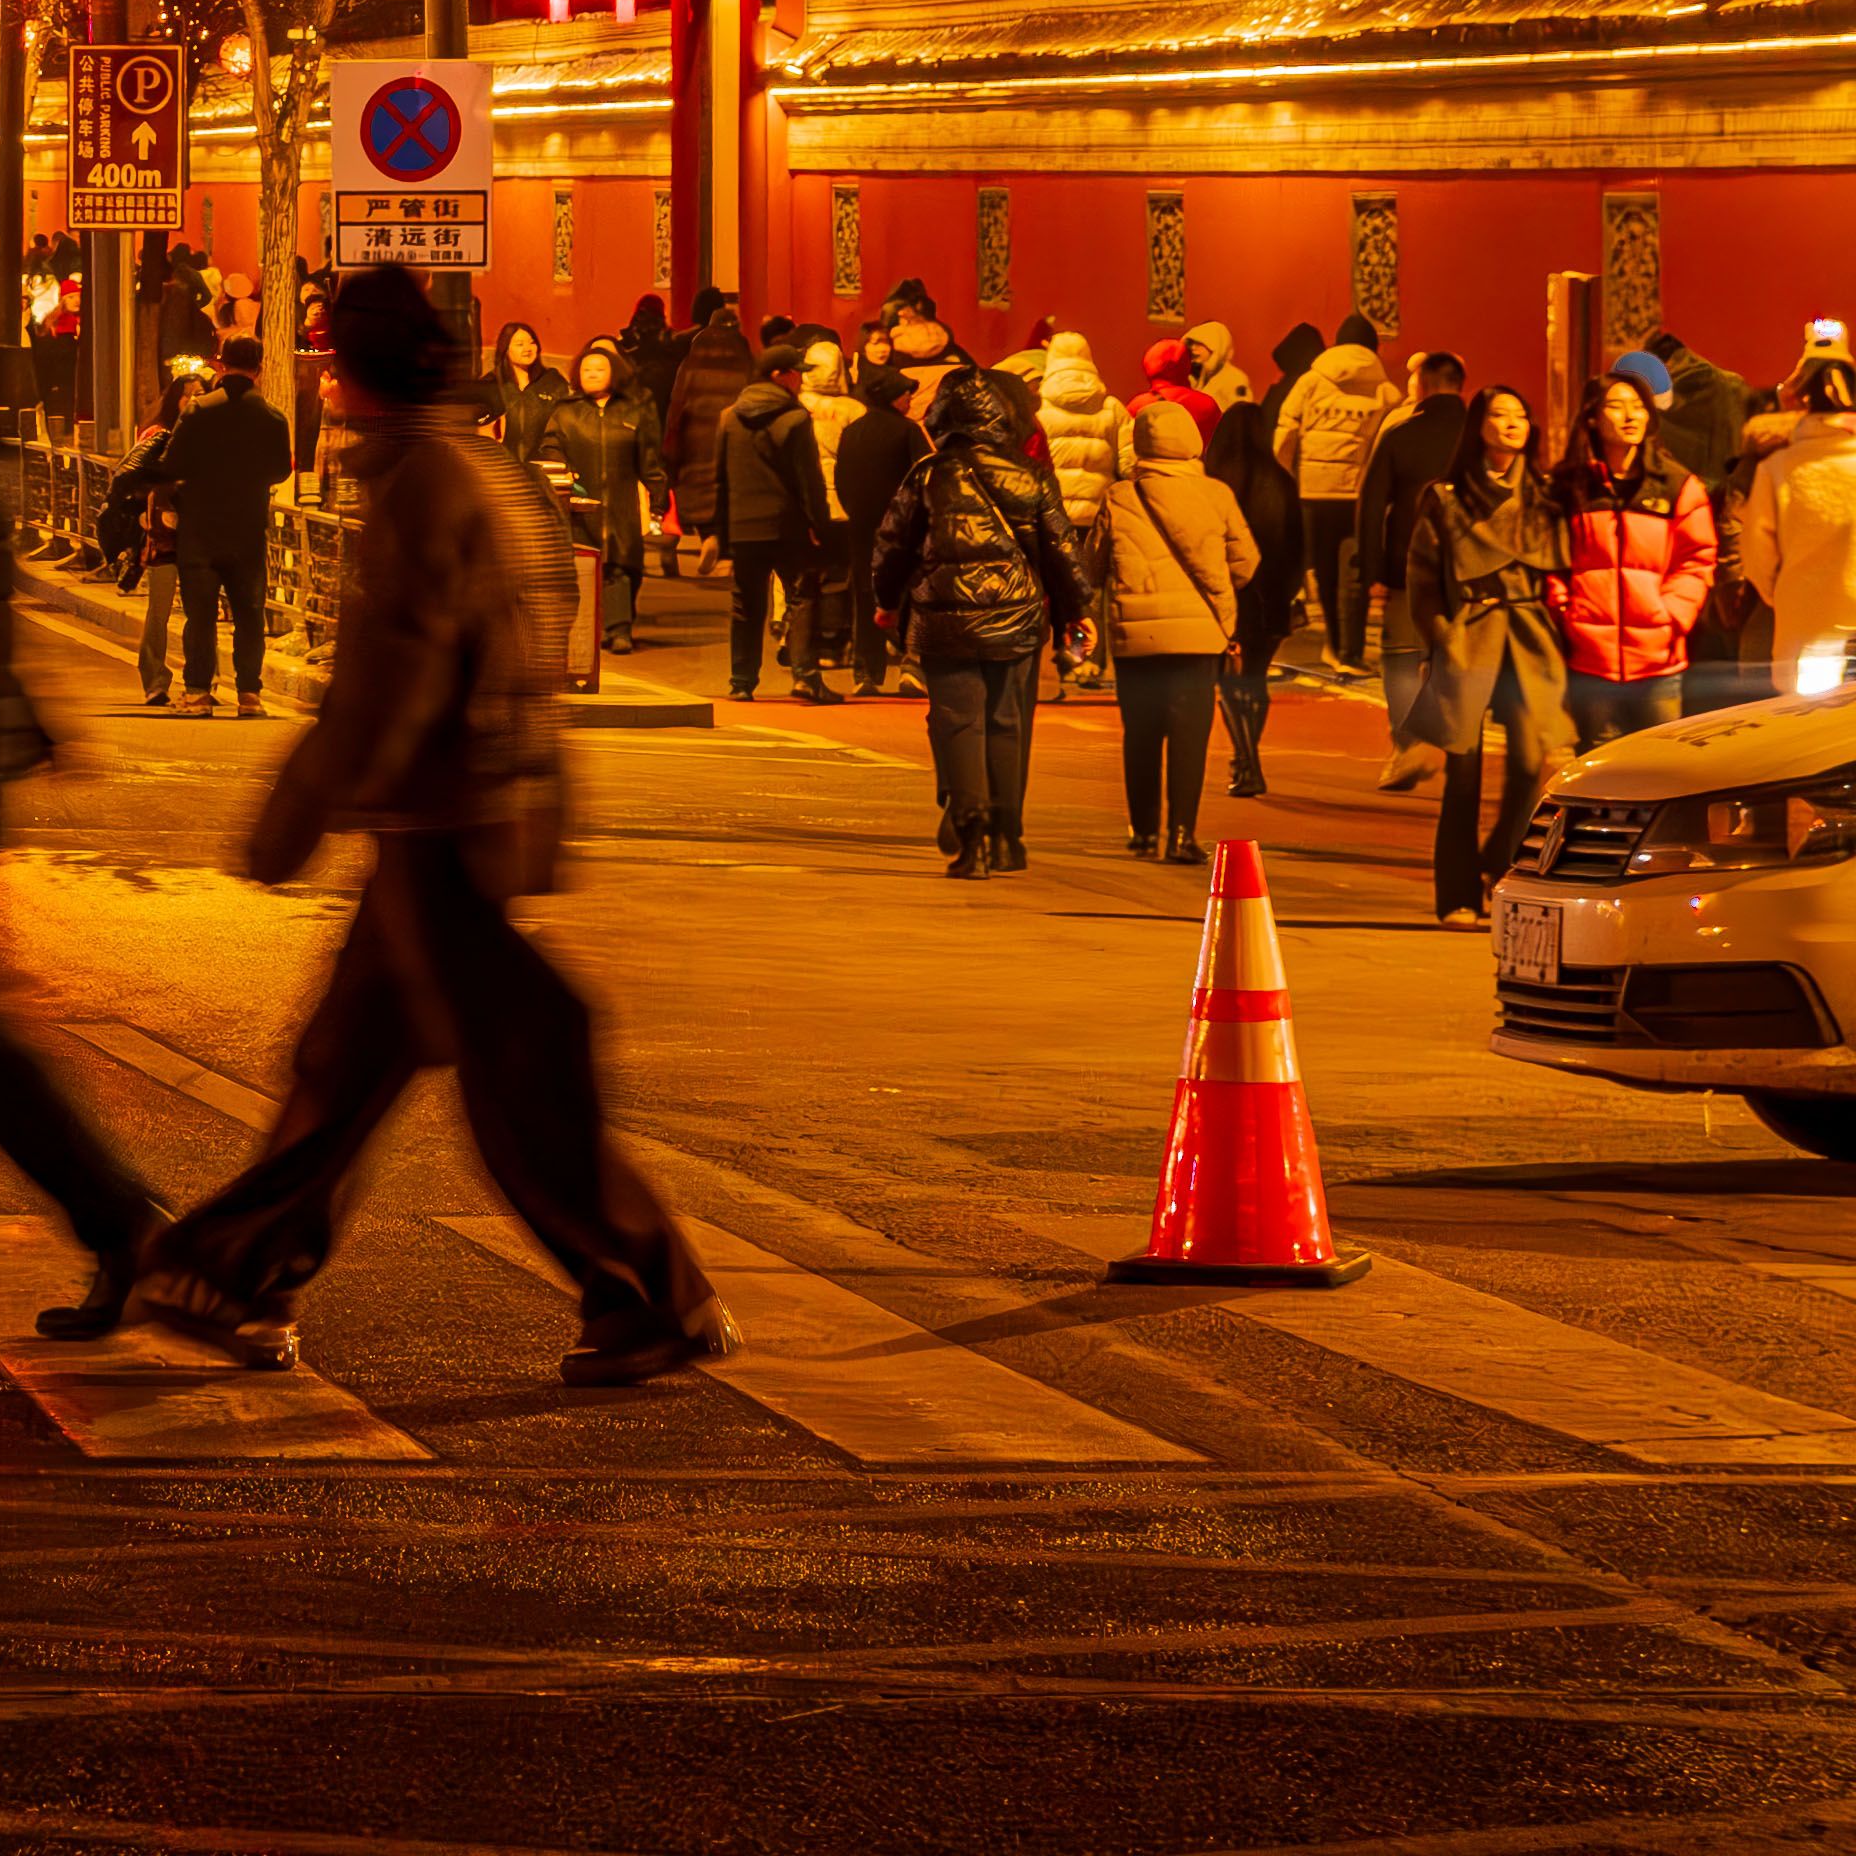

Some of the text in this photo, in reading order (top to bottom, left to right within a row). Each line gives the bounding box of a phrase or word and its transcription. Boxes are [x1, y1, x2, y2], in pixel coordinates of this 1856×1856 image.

[133, 67, 161, 103] P
[77, 54, 95, 159] 公共停车场
[99, 56, 112, 159] PUBLIC PARKING
[87, 162, 162, 188] 400m
[366, 198, 460, 219] 严管街
[364, 227, 461, 247] 清远街
